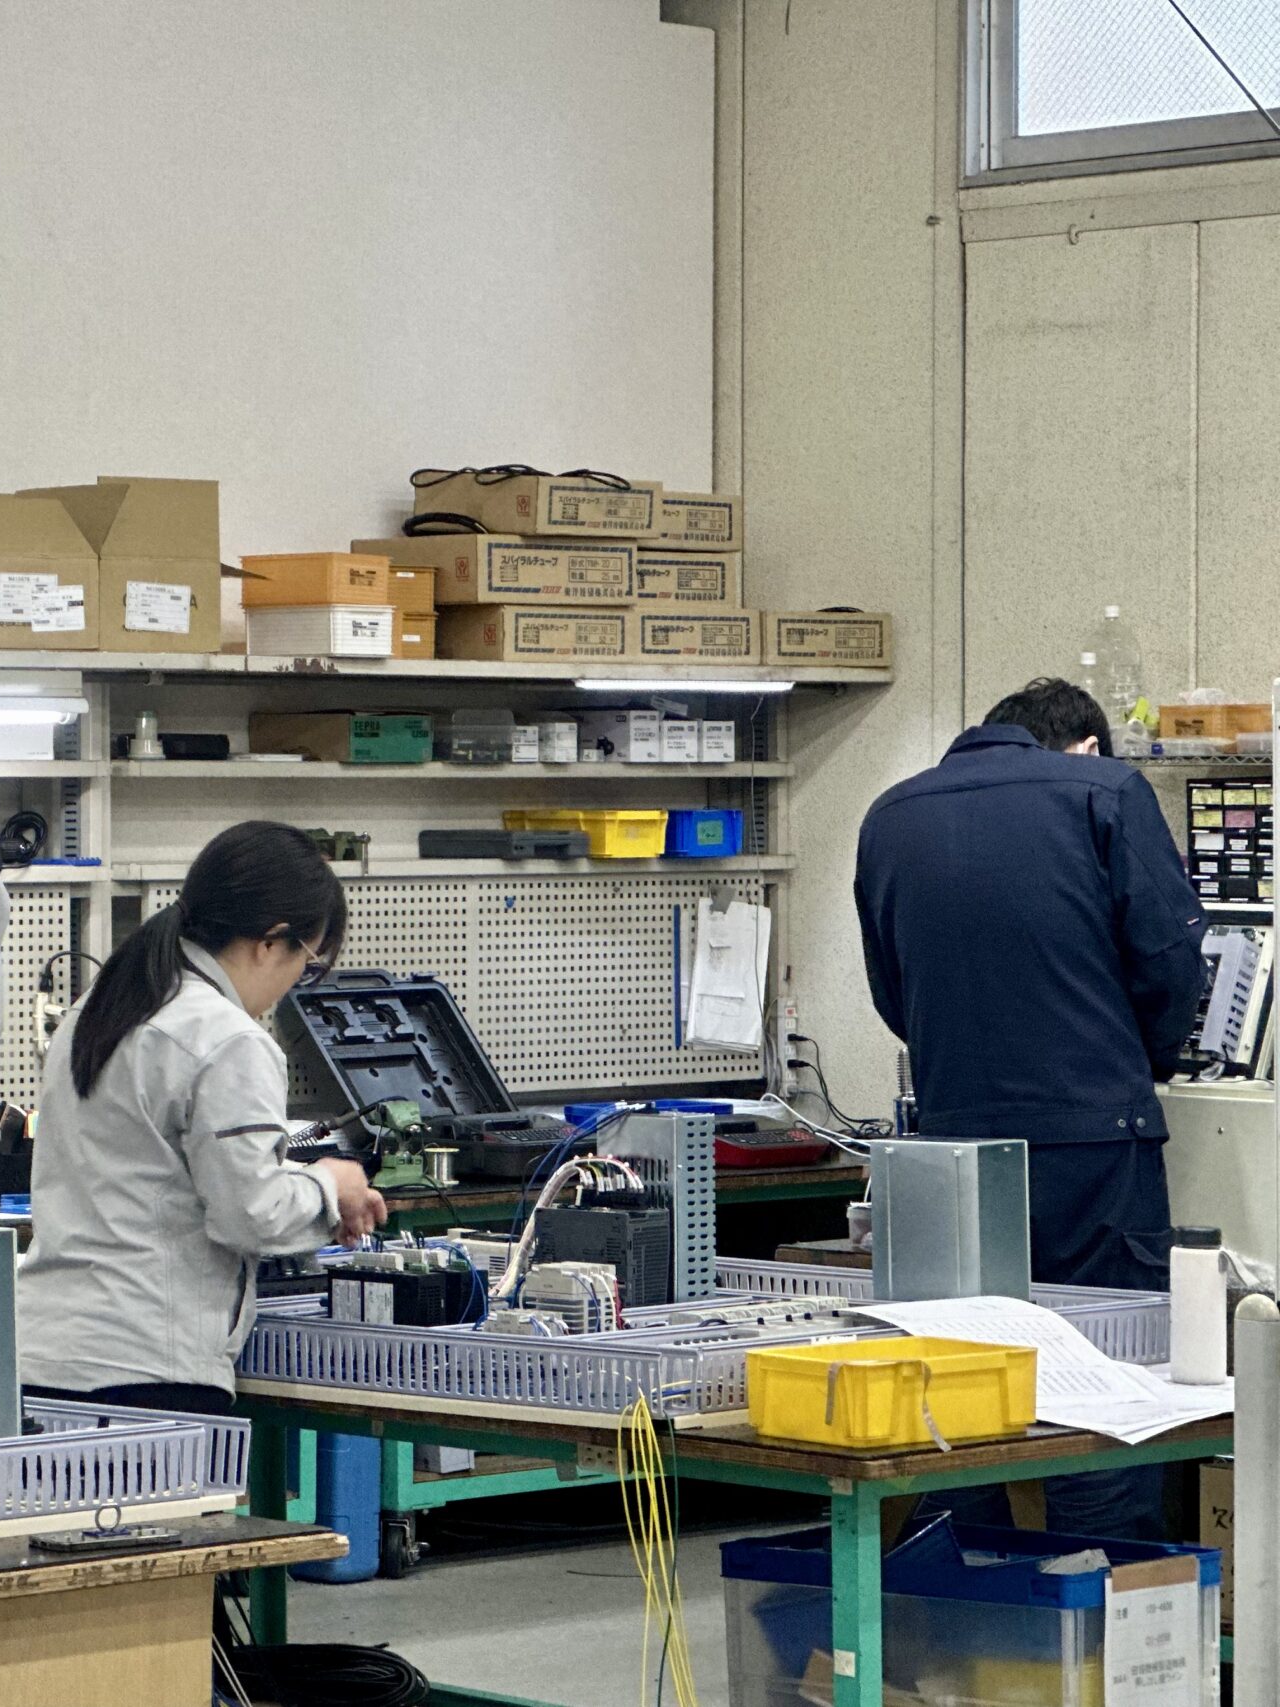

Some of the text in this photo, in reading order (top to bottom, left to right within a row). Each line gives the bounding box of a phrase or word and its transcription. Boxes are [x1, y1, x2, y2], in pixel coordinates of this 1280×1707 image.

[501, 555, 558, 567] スパイラルチューブ
[354, 720, 380, 731] TEPRA
